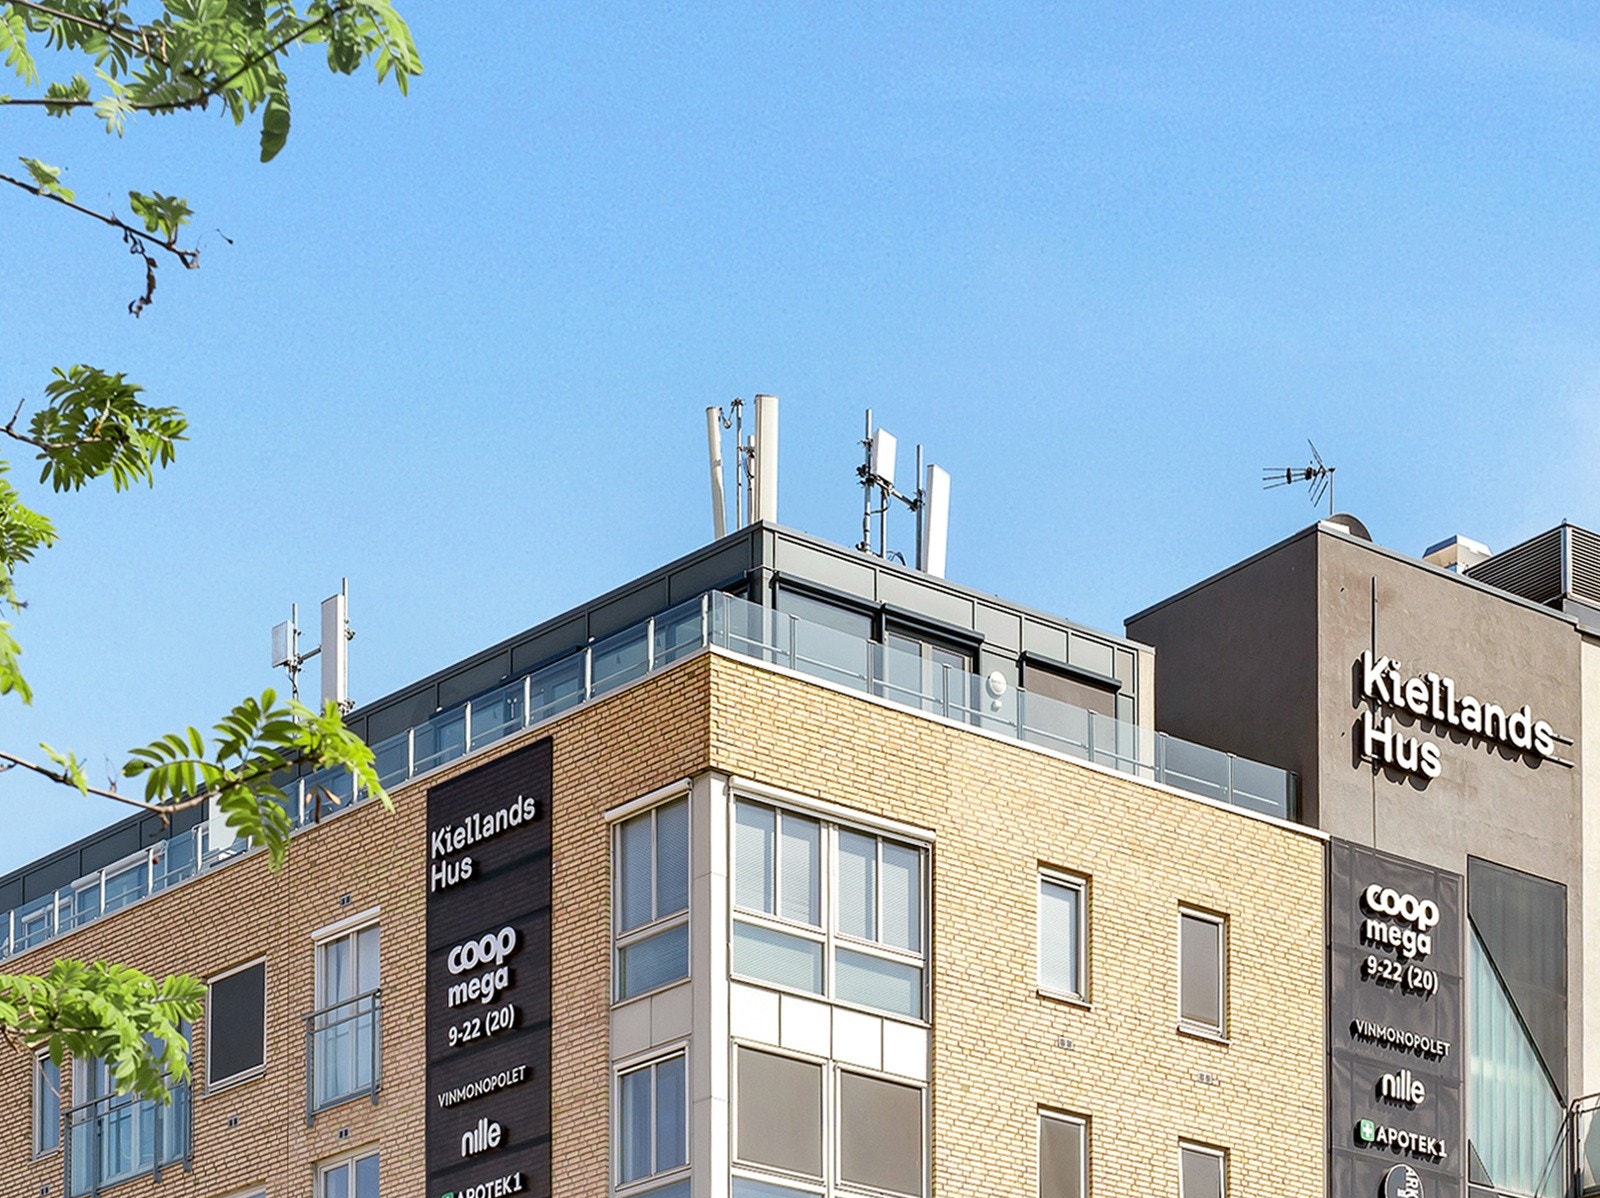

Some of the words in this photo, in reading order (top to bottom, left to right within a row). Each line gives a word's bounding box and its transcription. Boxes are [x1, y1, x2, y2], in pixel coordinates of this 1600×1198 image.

[1364, 650, 1555, 757] Kiellands
[1364, 710, 1442, 778] Hus
[431, 794, 535, 860] Kiellands
[431, 856, 473, 892] Hus
[1366, 884, 1440, 930] coop
[447, 926, 516, 974] coop
[1366, 918, 1431, 958] mega
[448, 966, 508, 1007] mega
[1367, 955, 1402, 982] 9-22
[1407, 965, 1438, 995] (20)
[449, 1017, 481, 1047] 9-22
[485, 1004, 515, 1036] (20)
[1355, 1018, 1451, 1056] VINMONOPOLET
[438, 1065, 526, 1108] VINMONOPOLET
[1382, 1069, 1425, 1104] nille
[461, 1117, 501, 1158] nille
